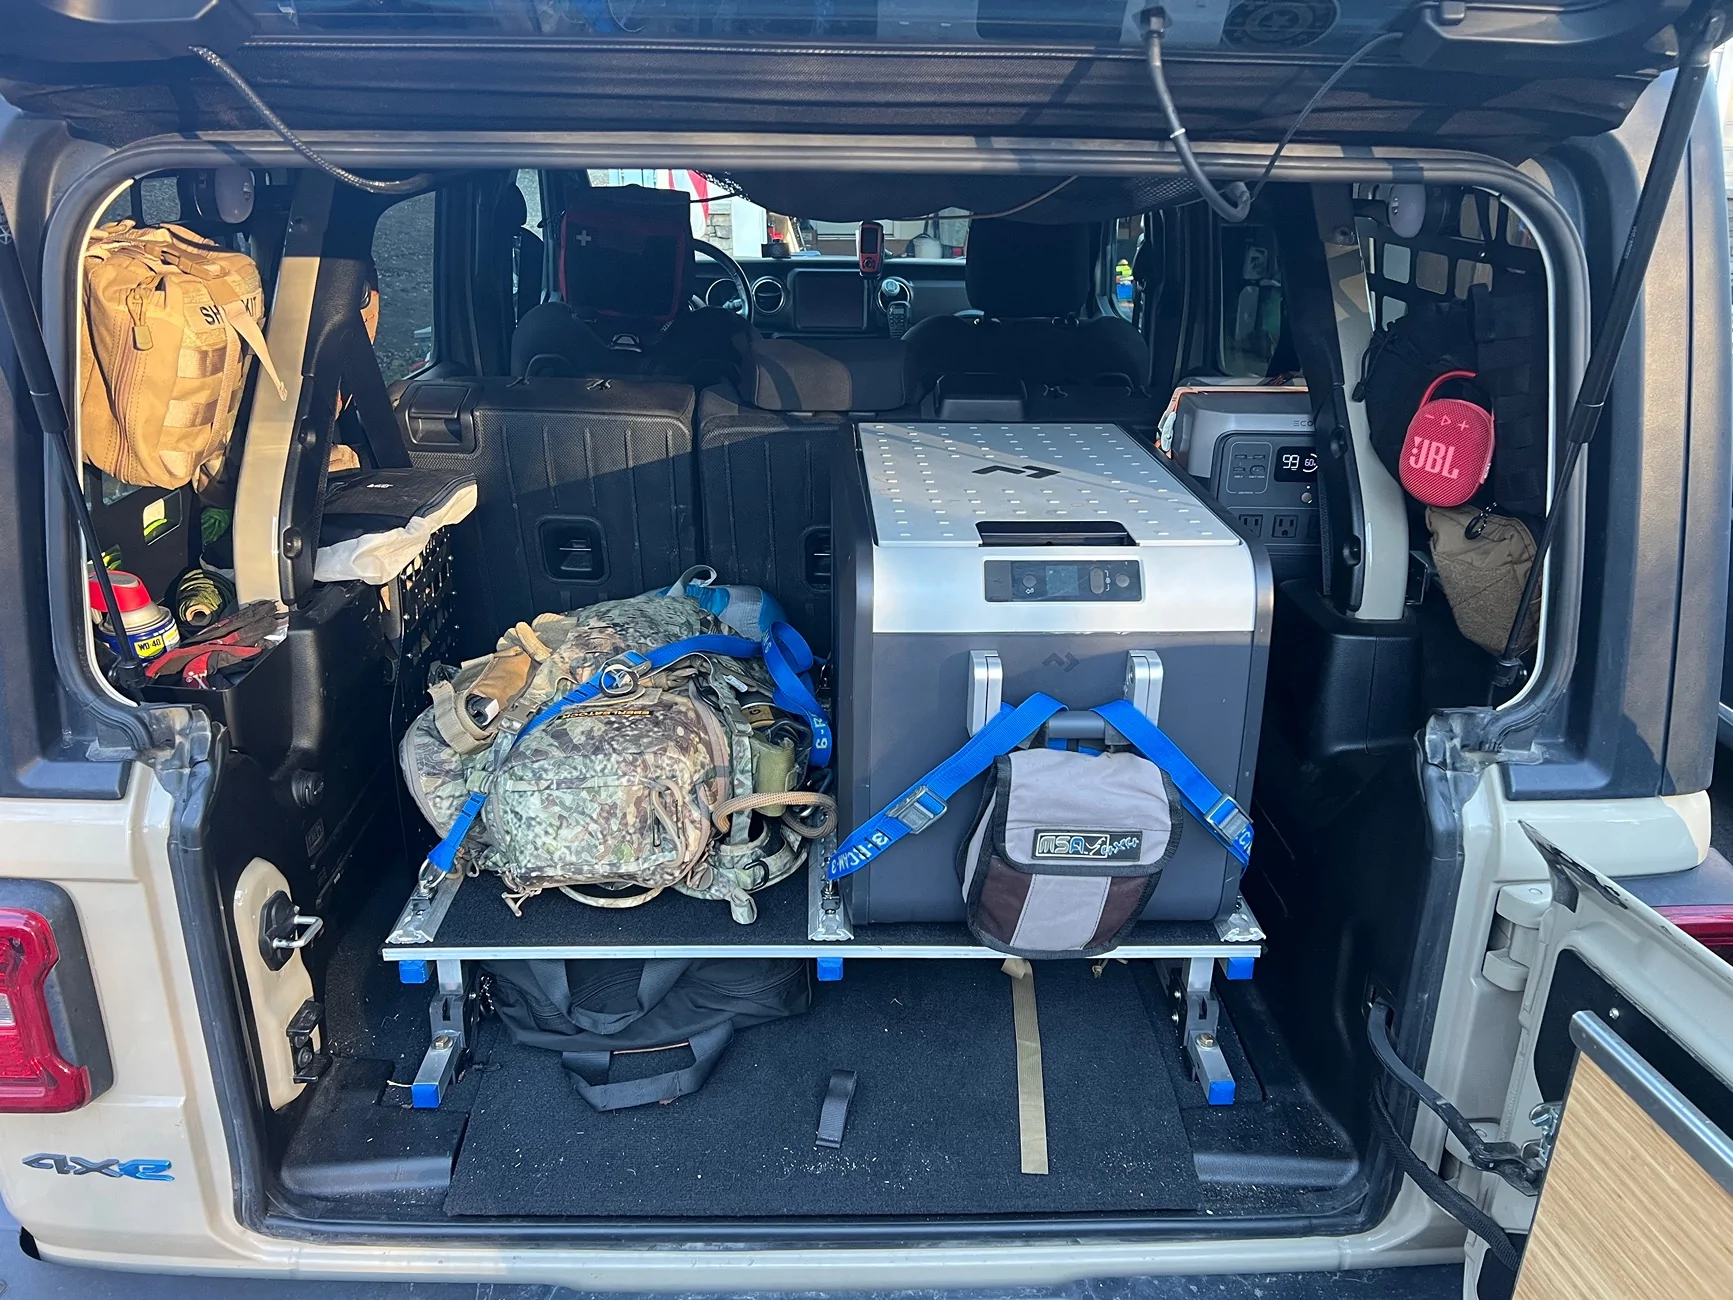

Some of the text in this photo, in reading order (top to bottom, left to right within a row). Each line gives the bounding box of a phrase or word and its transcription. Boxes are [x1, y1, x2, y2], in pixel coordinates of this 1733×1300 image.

[1282, 454, 1300, 469] 99
[1409, 436, 1459, 479] JBL
[137, 638, 162, 652] WD-40
[1038, 836, 1085, 854] MSA
